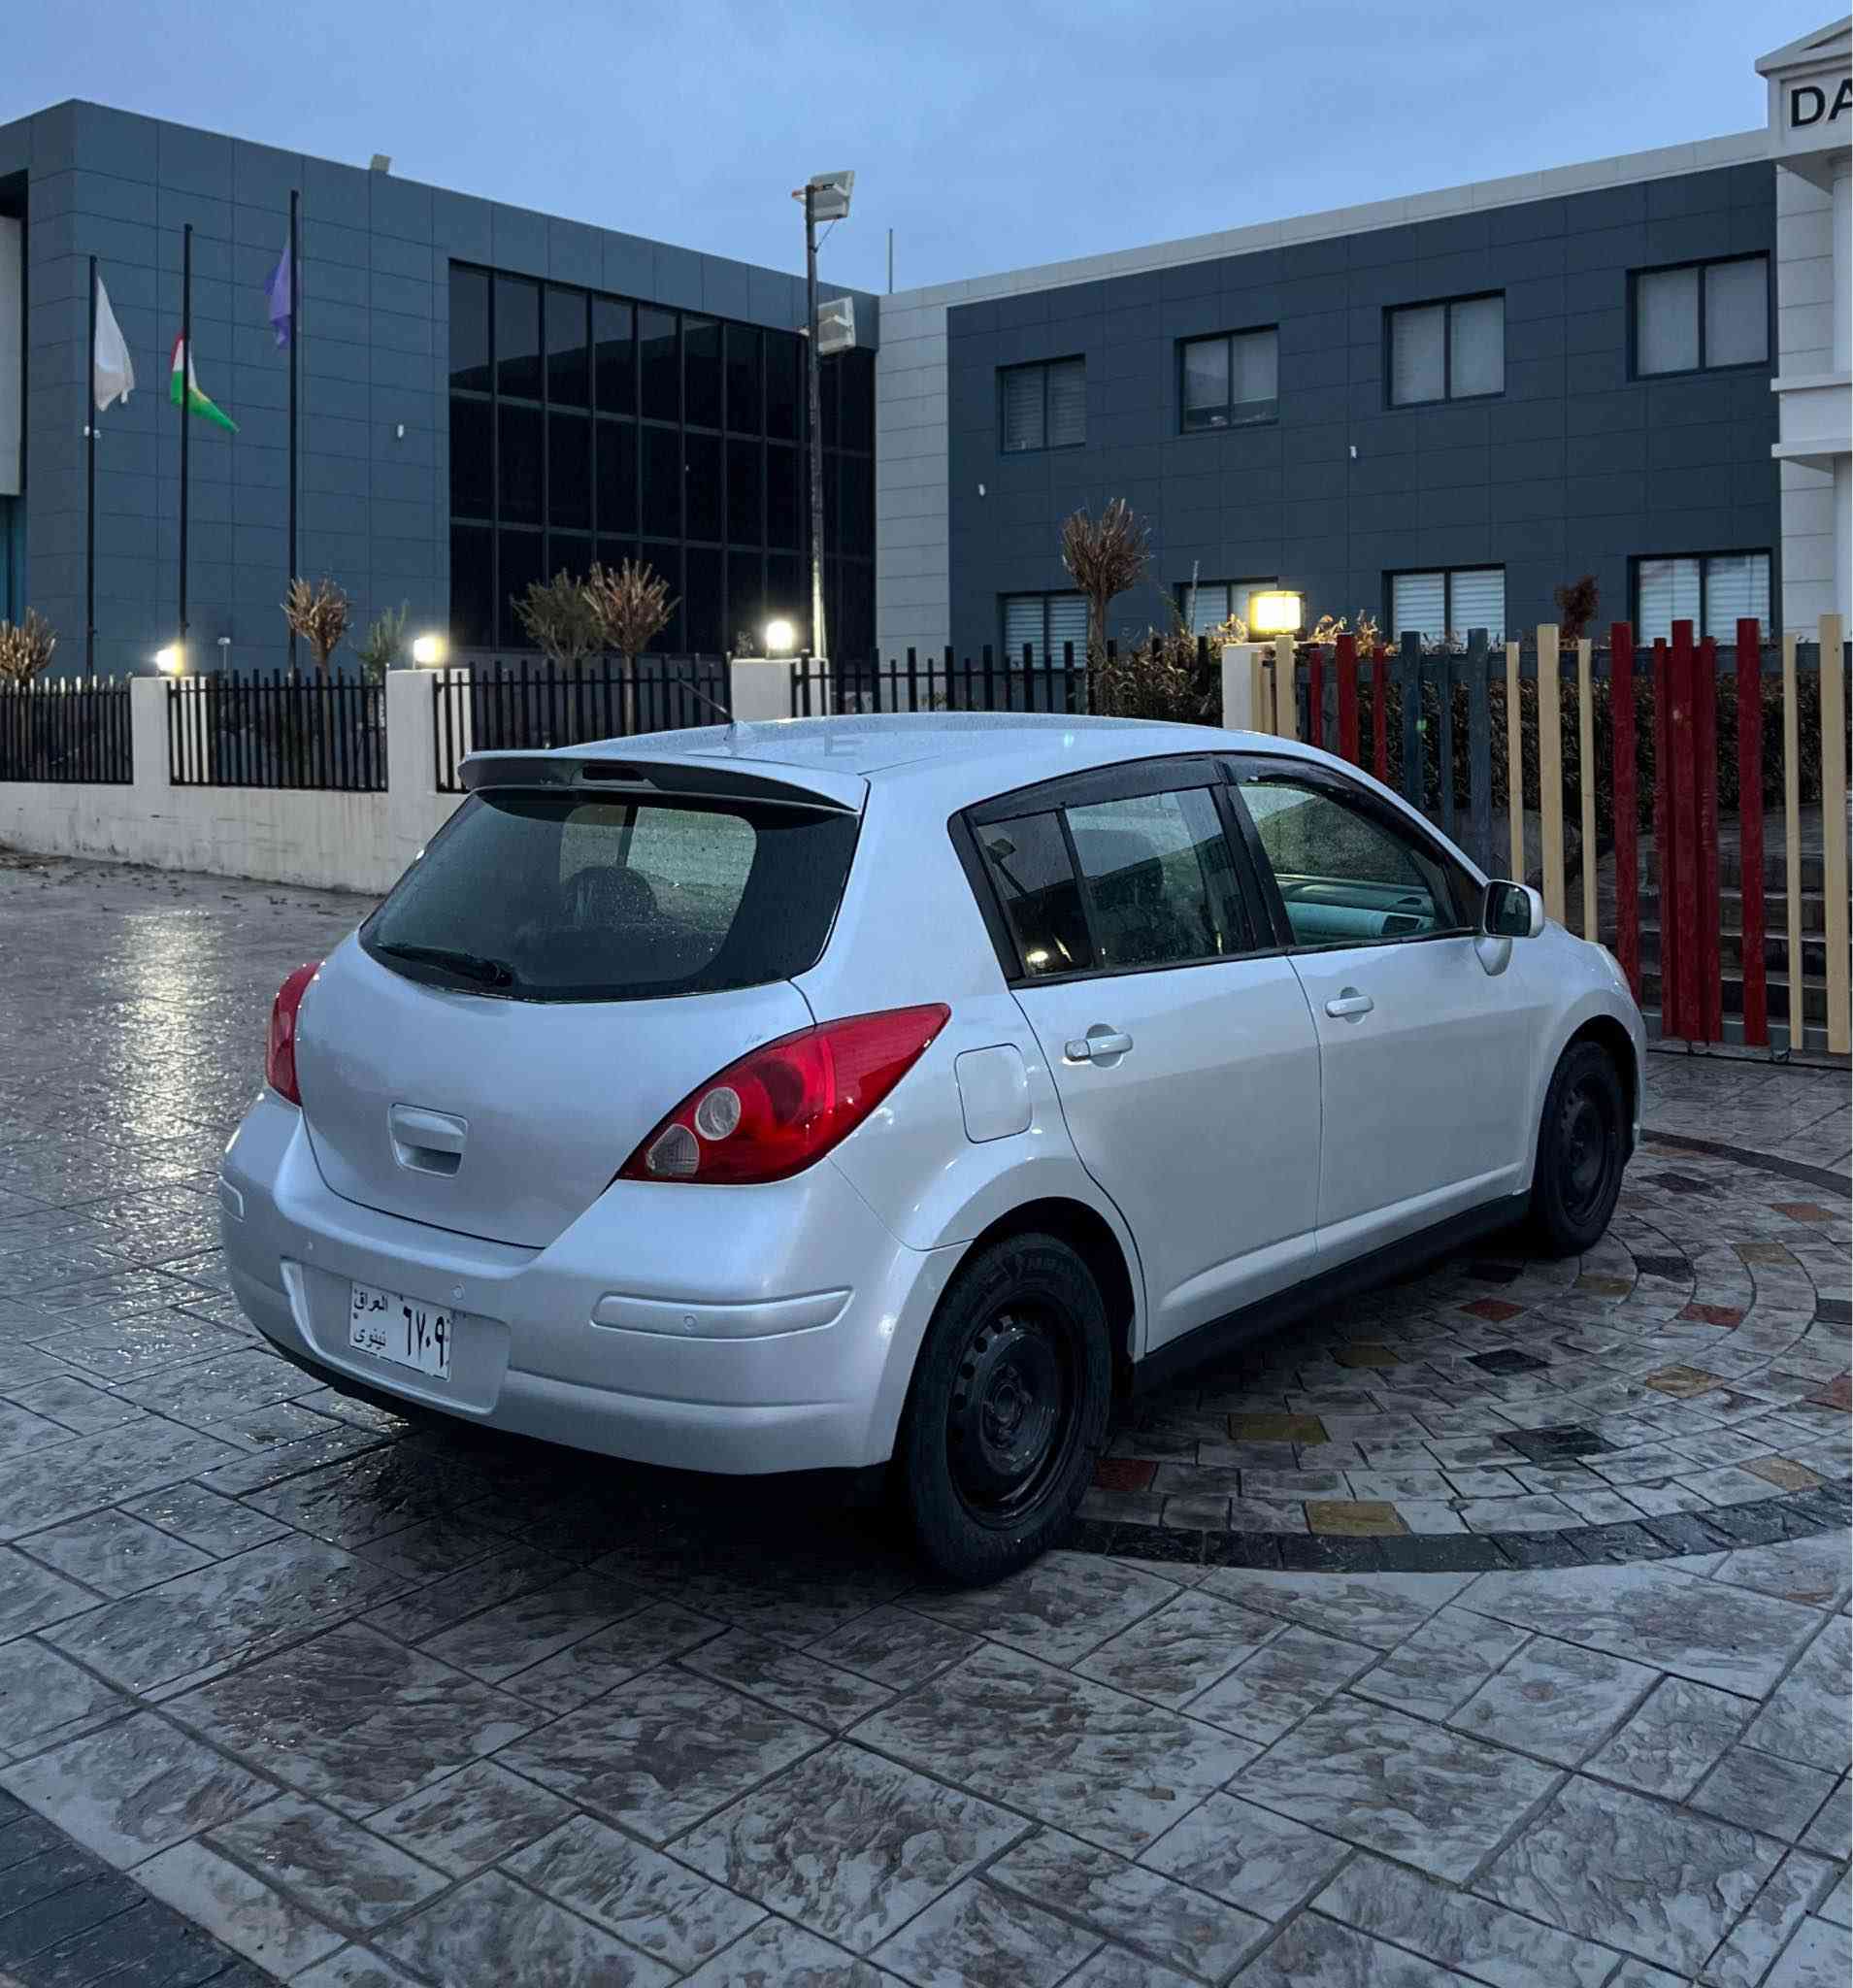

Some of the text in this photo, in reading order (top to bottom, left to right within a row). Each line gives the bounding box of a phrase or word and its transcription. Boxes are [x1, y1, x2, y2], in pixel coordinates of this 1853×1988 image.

[353, 1289, 388, 1312] العراق
[353, 1328, 386, 1350] نينوى
[403, 1306, 445, 1370] ٦٧٠٩
